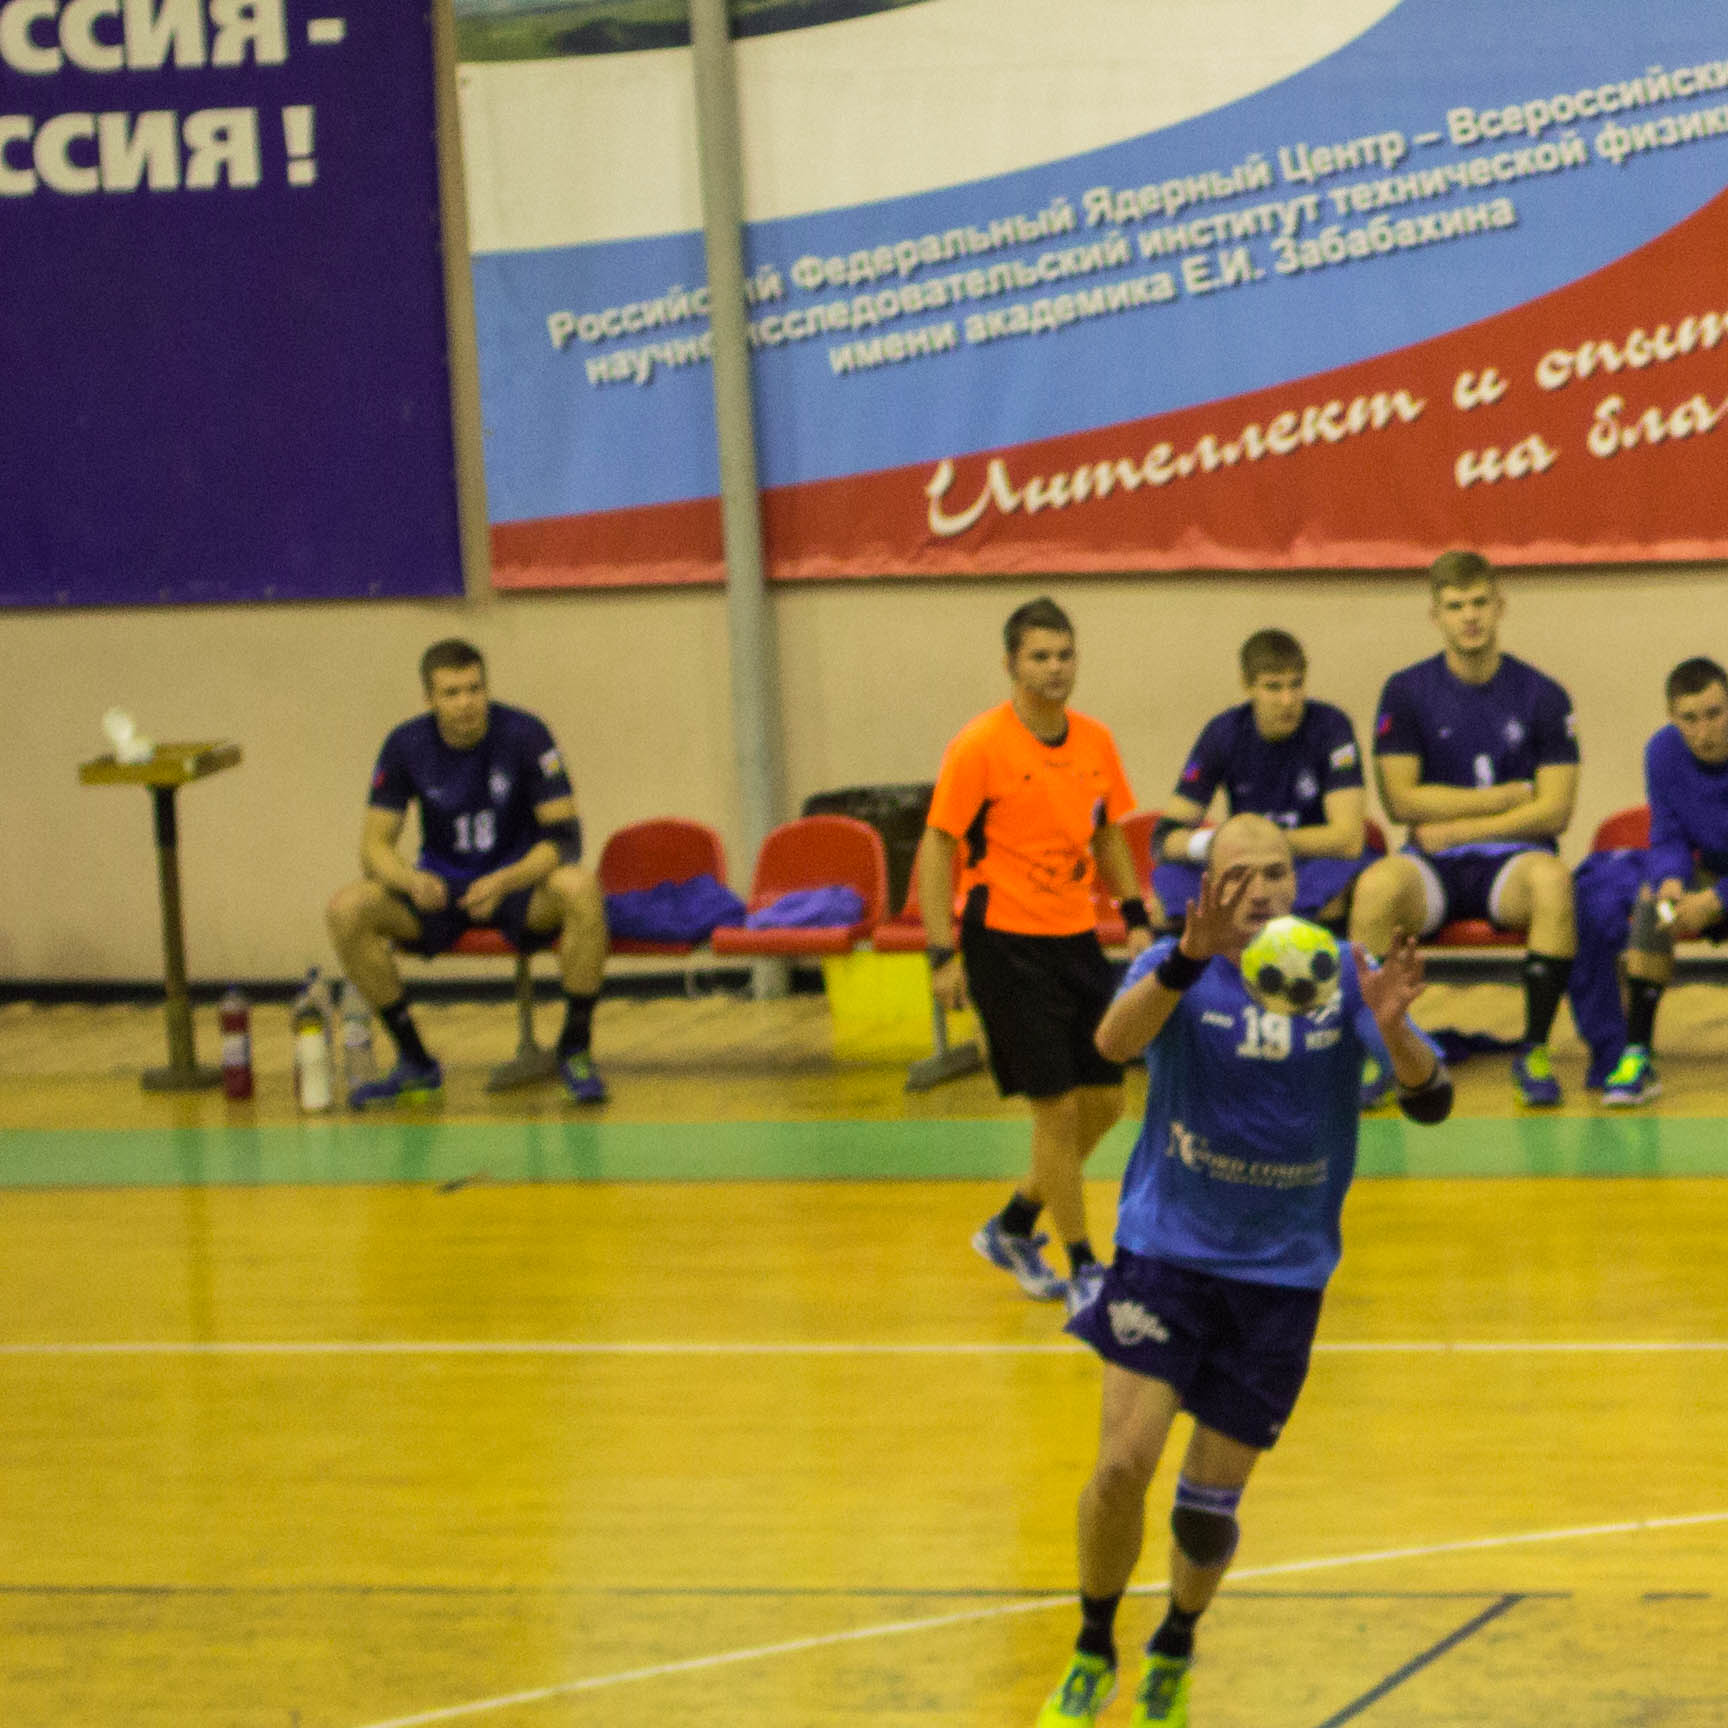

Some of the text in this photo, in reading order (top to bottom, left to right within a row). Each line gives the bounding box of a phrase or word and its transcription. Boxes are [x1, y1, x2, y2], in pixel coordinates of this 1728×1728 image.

[547, 264, 784, 350] Российсй
[791, 198, 1077, 290] Федеральный
[1082, 153, 1273, 228] Ядерный
[1278, 130, 1407, 184] Центр
[1138, 194, 1318, 259] институт
[1328, 131, 1588, 215] технической
[830, 198, 1516, 374] имени академика Е.И. Забабахина
[925, 388, 1426, 537] Интеллект
[1453, 366, 1509, 411] и
[1454, 433, 1558, 488] на
[1236, 1004, 1291, 1061] 19
